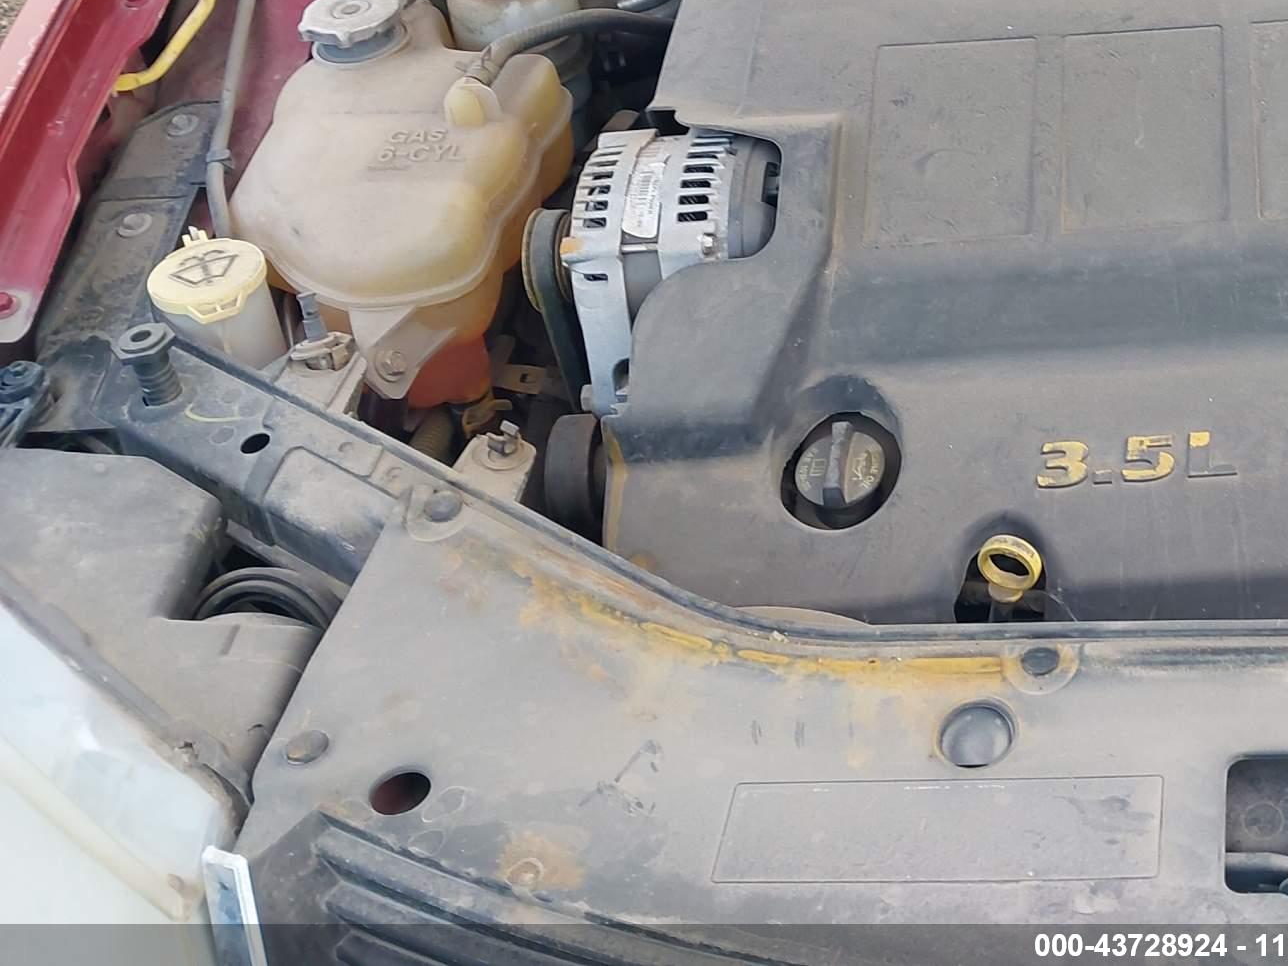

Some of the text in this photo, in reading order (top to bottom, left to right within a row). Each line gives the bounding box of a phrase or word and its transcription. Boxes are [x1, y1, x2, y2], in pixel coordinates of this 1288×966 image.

[390, 130, 447, 144] GAS
[379, 145, 462, 162] 6-CYL
[1036, 430, 1237, 489] 3.5L
